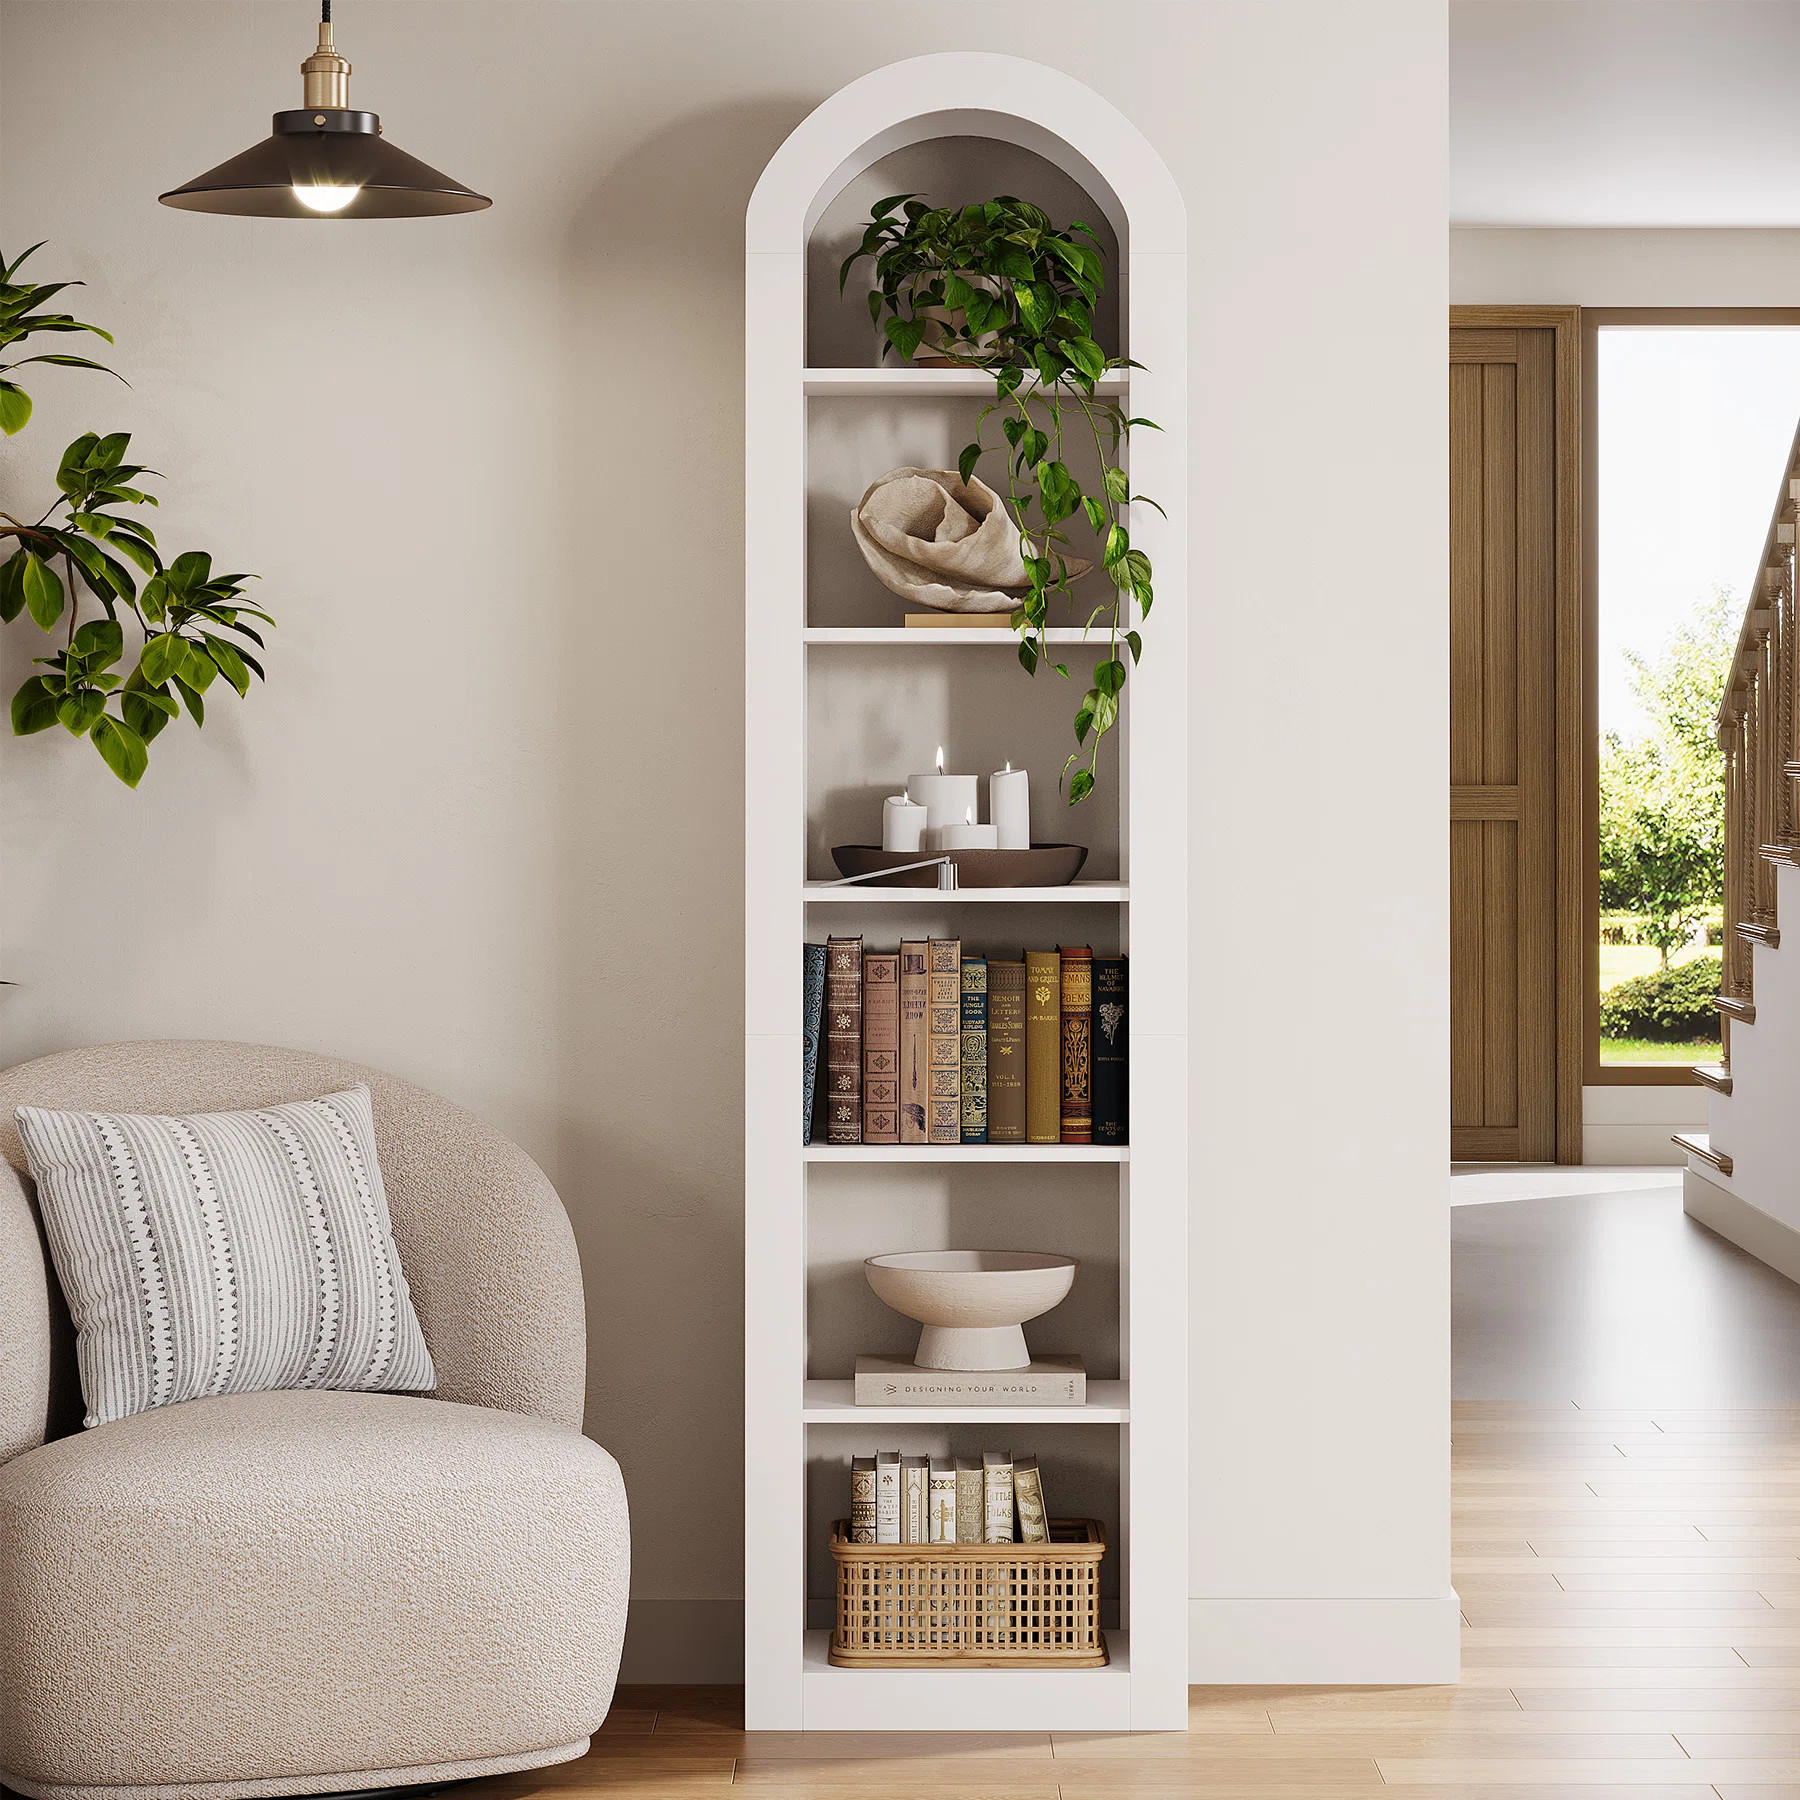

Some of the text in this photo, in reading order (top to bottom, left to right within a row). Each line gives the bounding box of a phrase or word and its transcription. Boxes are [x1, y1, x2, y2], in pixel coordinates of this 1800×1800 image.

[1030, 966, 1054, 974] TOMMY
[1061, 993, 1091, 1003] POEMS
[986, 1505, 1012, 1520] FOLKS
